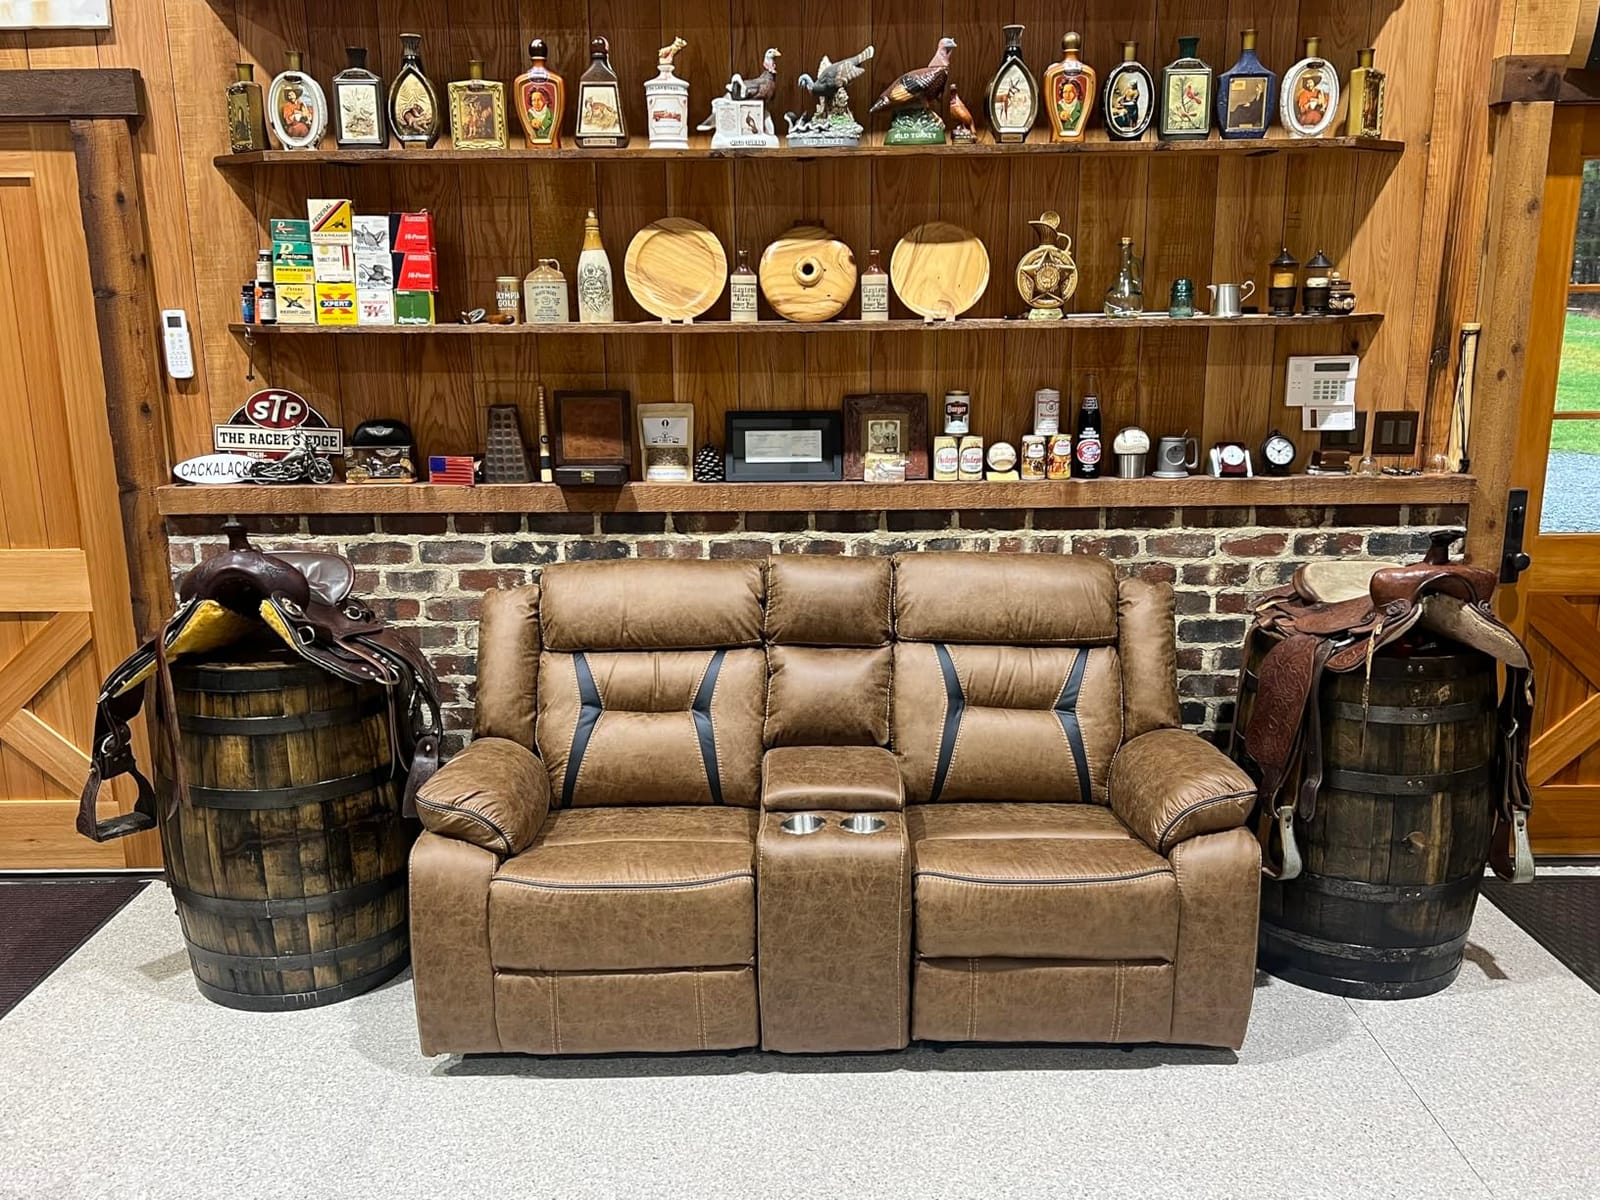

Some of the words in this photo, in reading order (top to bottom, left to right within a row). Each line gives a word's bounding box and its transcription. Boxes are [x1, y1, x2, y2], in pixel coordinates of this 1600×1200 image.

[497, 299, 517, 308] GOLD
[252, 394, 302, 423] STP
[219, 431, 245, 446] THE
[249, 432, 301, 447] RACERS
[305, 434, 338, 448] EDGE
